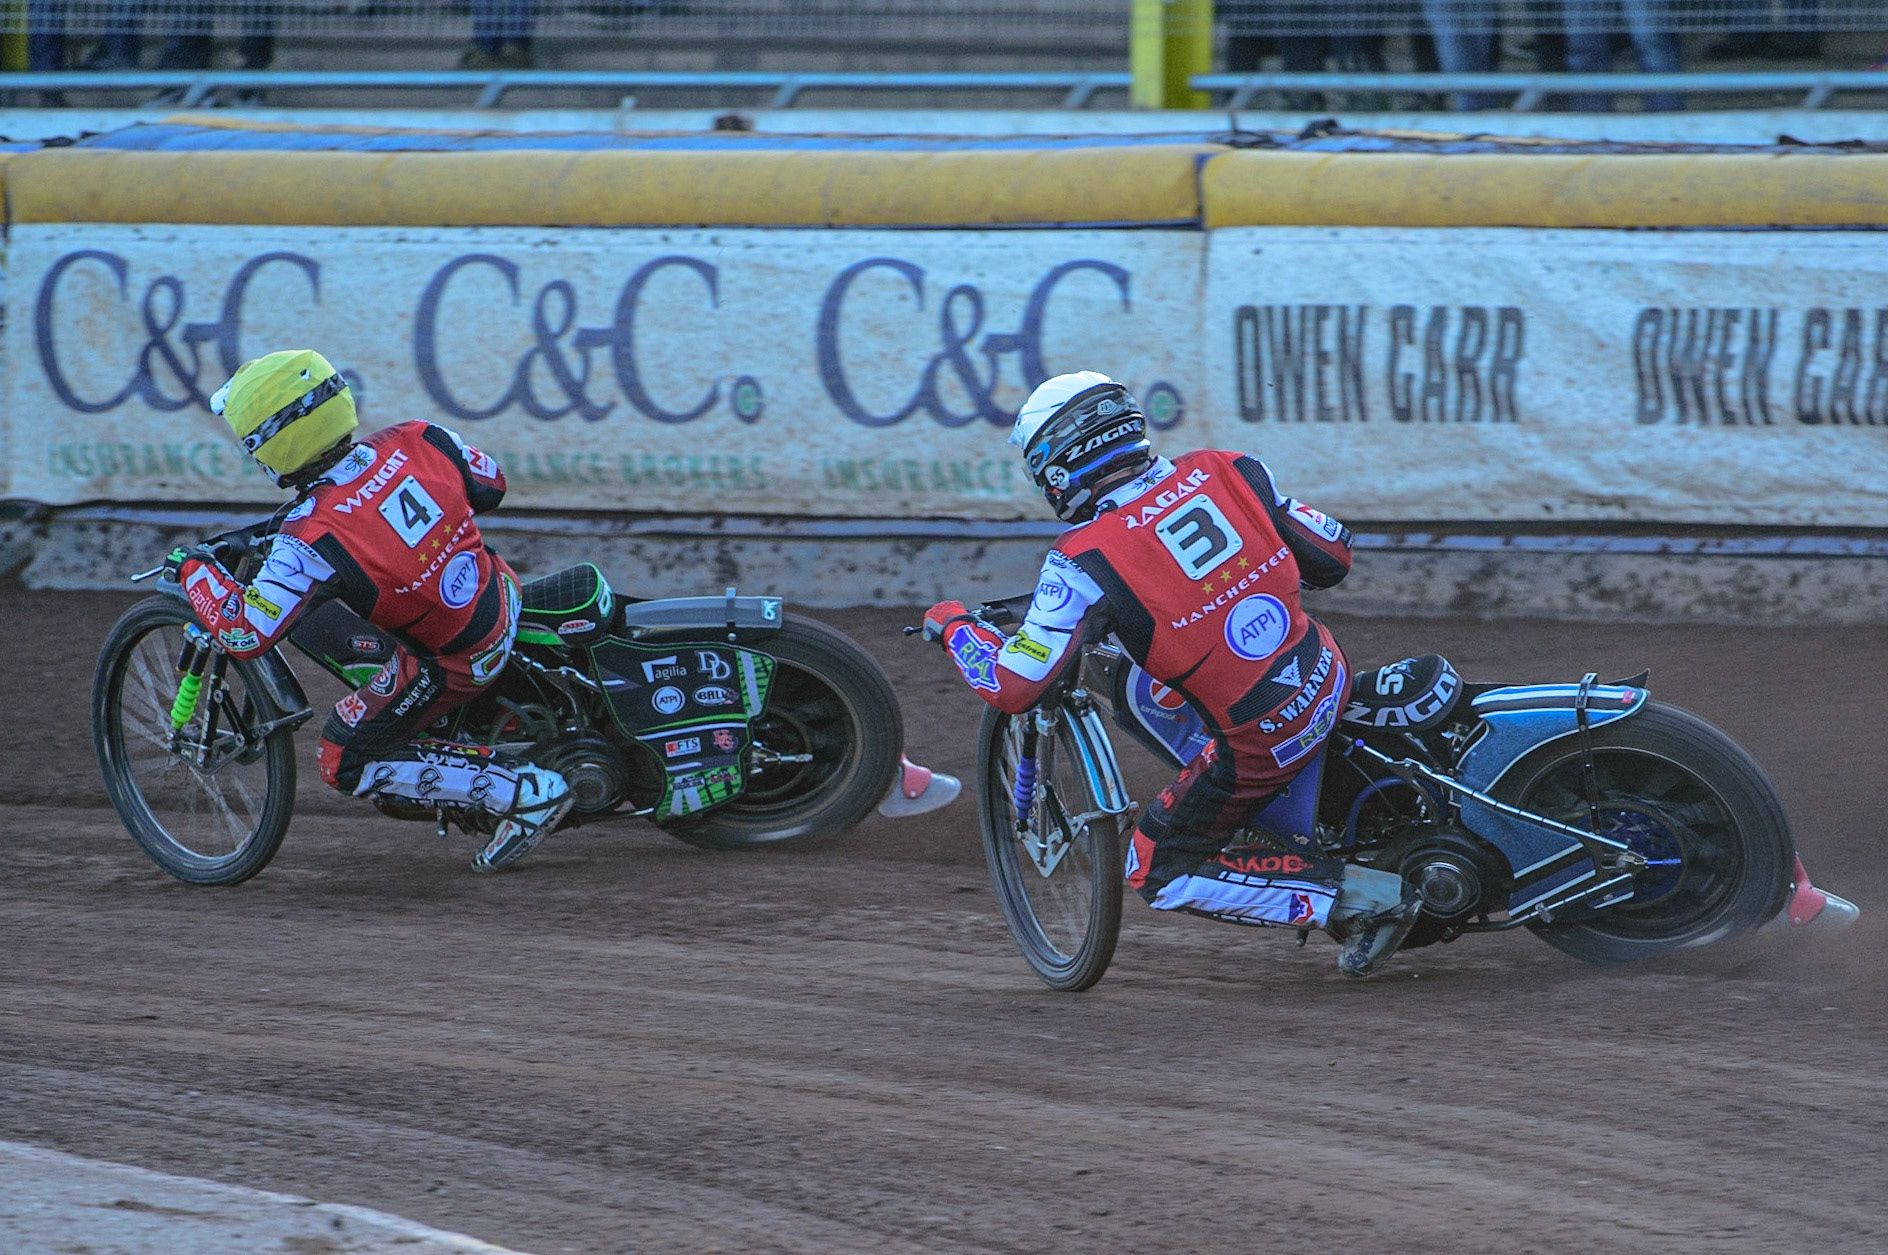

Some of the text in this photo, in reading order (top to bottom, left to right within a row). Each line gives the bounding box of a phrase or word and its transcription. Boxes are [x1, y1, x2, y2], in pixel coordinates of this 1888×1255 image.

[1233, 305, 1525, 423] OWEN CARR
[1633, 307, 1780, 425] OWEN
[332, 448, 409, 514] WRIGHT
[1049, 468, 1065, 487] 55
[398, 487, 432, 530] 4
[394, 508, 475, 595] MANCHESTER
[1166, 507, 1228, 570] 3
[449, 562, 472, 598] ATPI
[1038, 582, 1064, 599] ATPI
[1171, 546, 1290, 630] MANCHESTER
[1240, 608, 1277, 646] ATPI
[655, 665, 688, 681] agilia
[960, 642, 991, 682] REAL
[395, 685, 421, 717] ROBERT
[1278, 645, 1334, 723] WARNER
[677, 739, 699, 751] FTS
